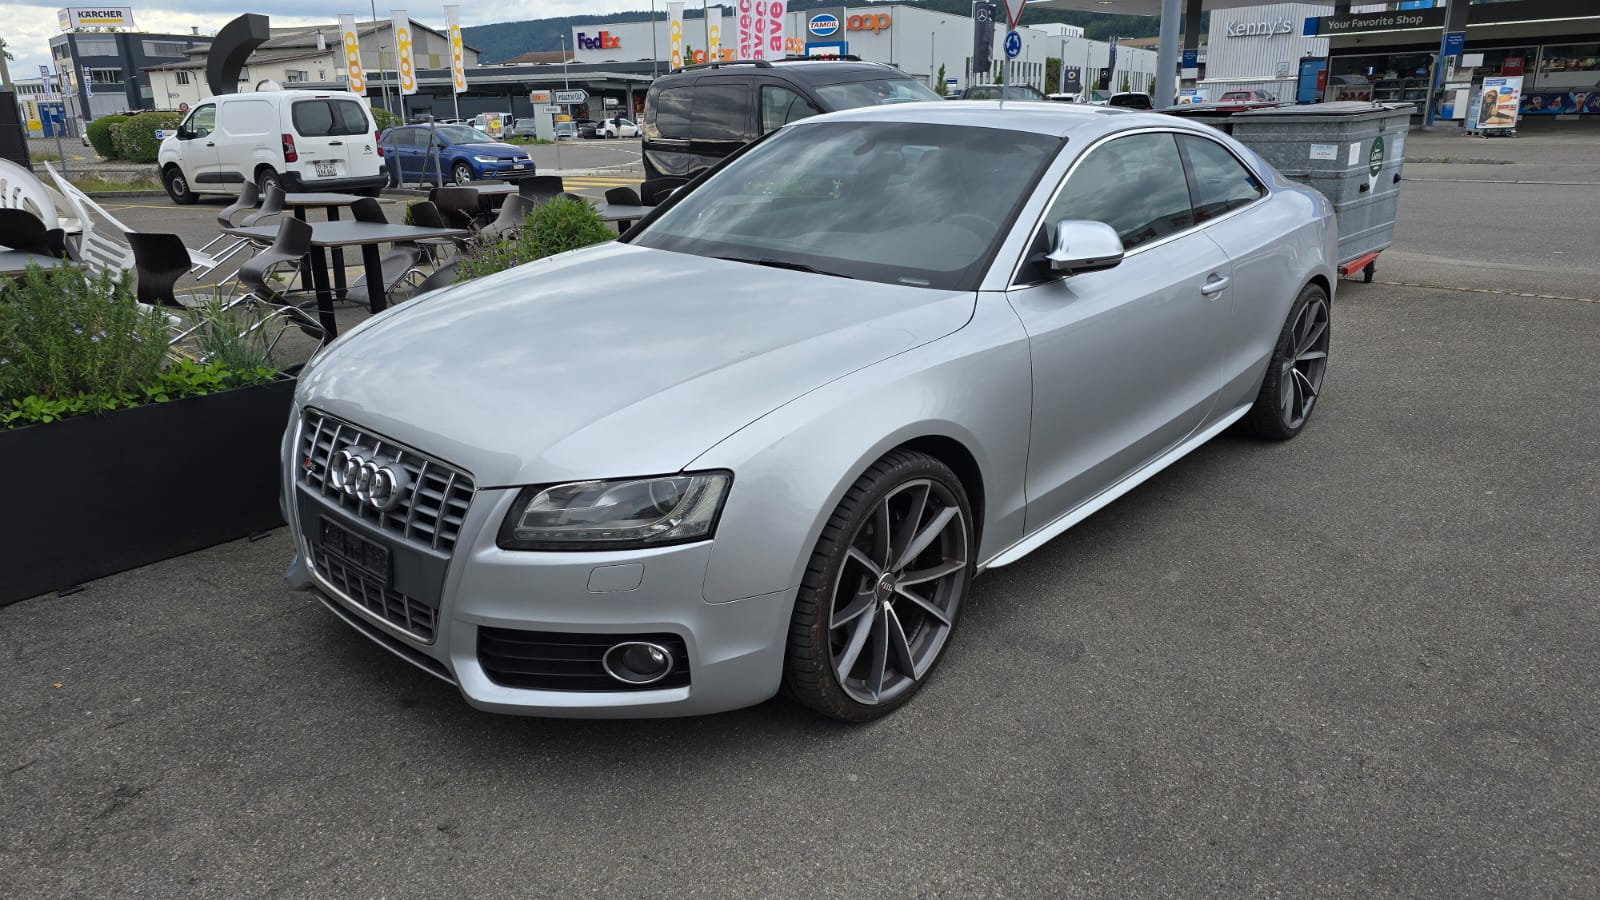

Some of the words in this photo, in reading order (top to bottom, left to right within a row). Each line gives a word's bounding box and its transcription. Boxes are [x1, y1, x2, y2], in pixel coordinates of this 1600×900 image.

[771, 2, 783, 52] ave
[847, 13, 891, 34] oop
[1226, 17, 1292, 39] Kenny's
[1328, 21, 1351, 30] Your
[1352, 17, 1394, 28] Favorite
[1396, 15, 1423, 25] Shop
[577, 31, 620, 49] FedEx
